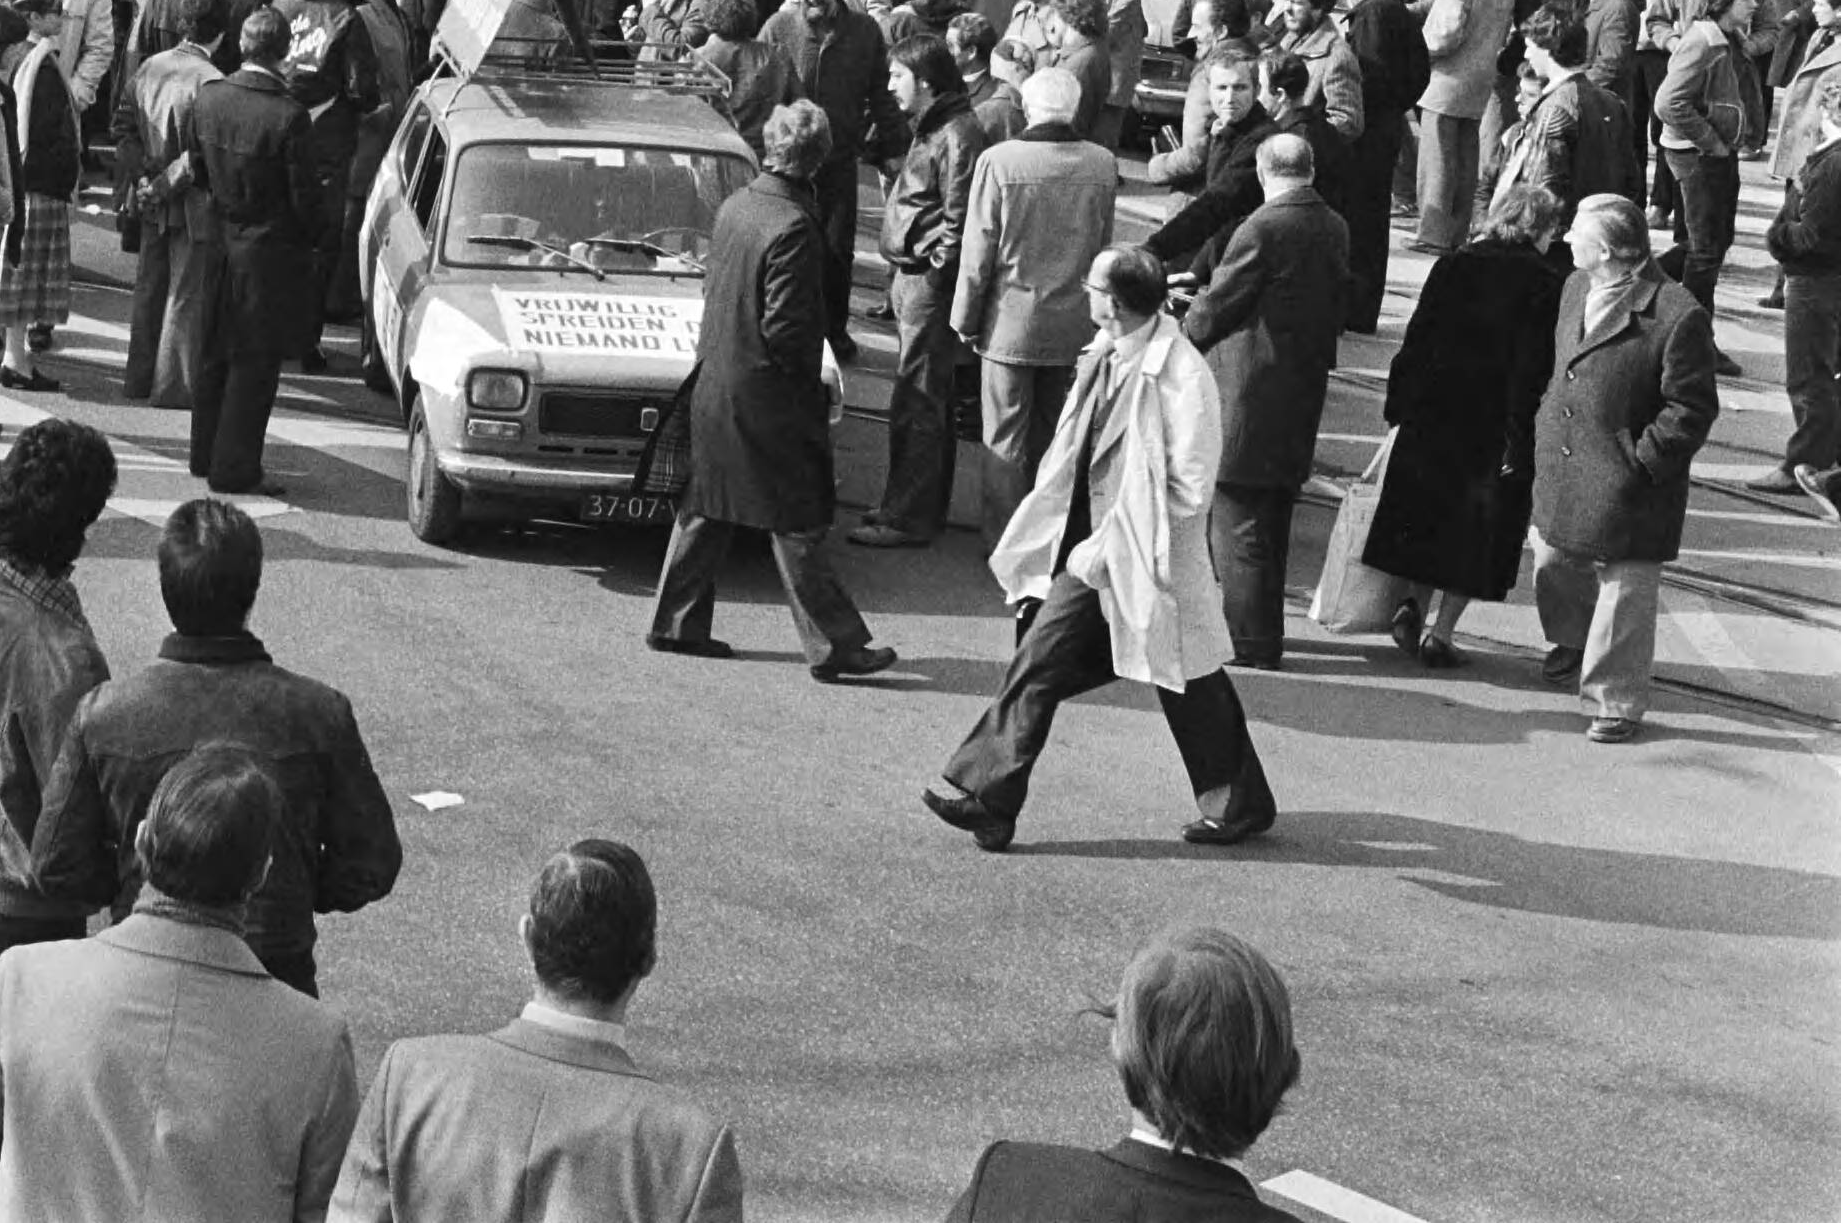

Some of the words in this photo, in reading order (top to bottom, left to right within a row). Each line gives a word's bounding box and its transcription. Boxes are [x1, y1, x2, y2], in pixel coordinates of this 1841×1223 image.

[515, 297, 678, 318] VRIJWILLIG
[520, 311, 665, 332] SPREIDEN
[523, 328, 662, 351] NIEMAND
